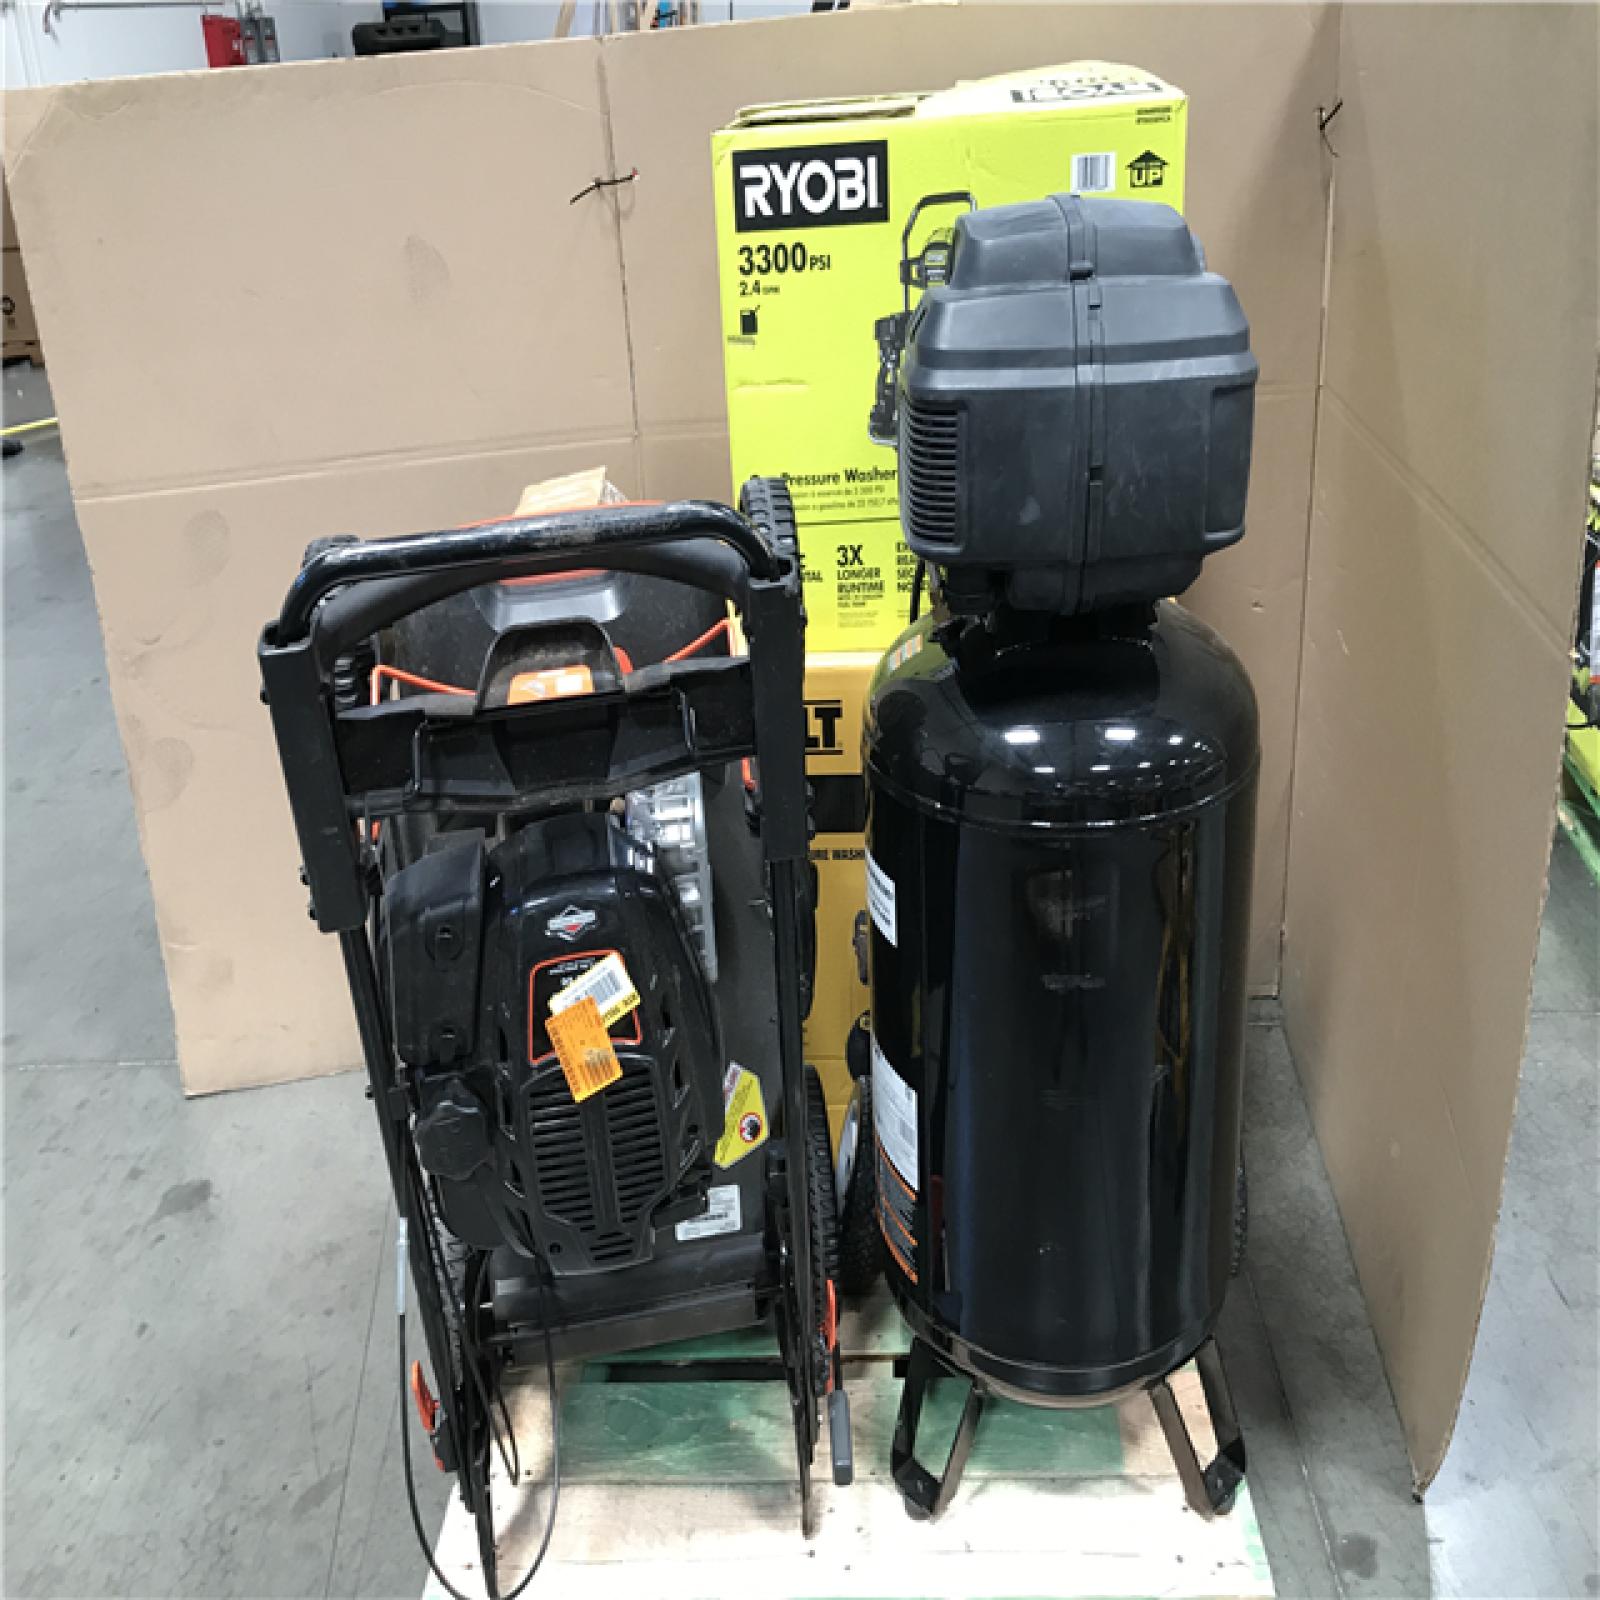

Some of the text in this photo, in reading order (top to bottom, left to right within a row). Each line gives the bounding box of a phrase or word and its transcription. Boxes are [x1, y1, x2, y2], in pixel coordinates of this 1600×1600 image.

[738, 154, 881, 219] RYOBI
[1130, 166, 1163, 188] UP
[738, 242, 831, 276] 3300 PSI
[739, 280, 761, 296] 2.4
[845, 465, 896, 482] Washer
[837, 544, 863, 567] 3X
[838, 567, 880, 581] LONGER
[838, 580, 884, 593] RUNTIME
